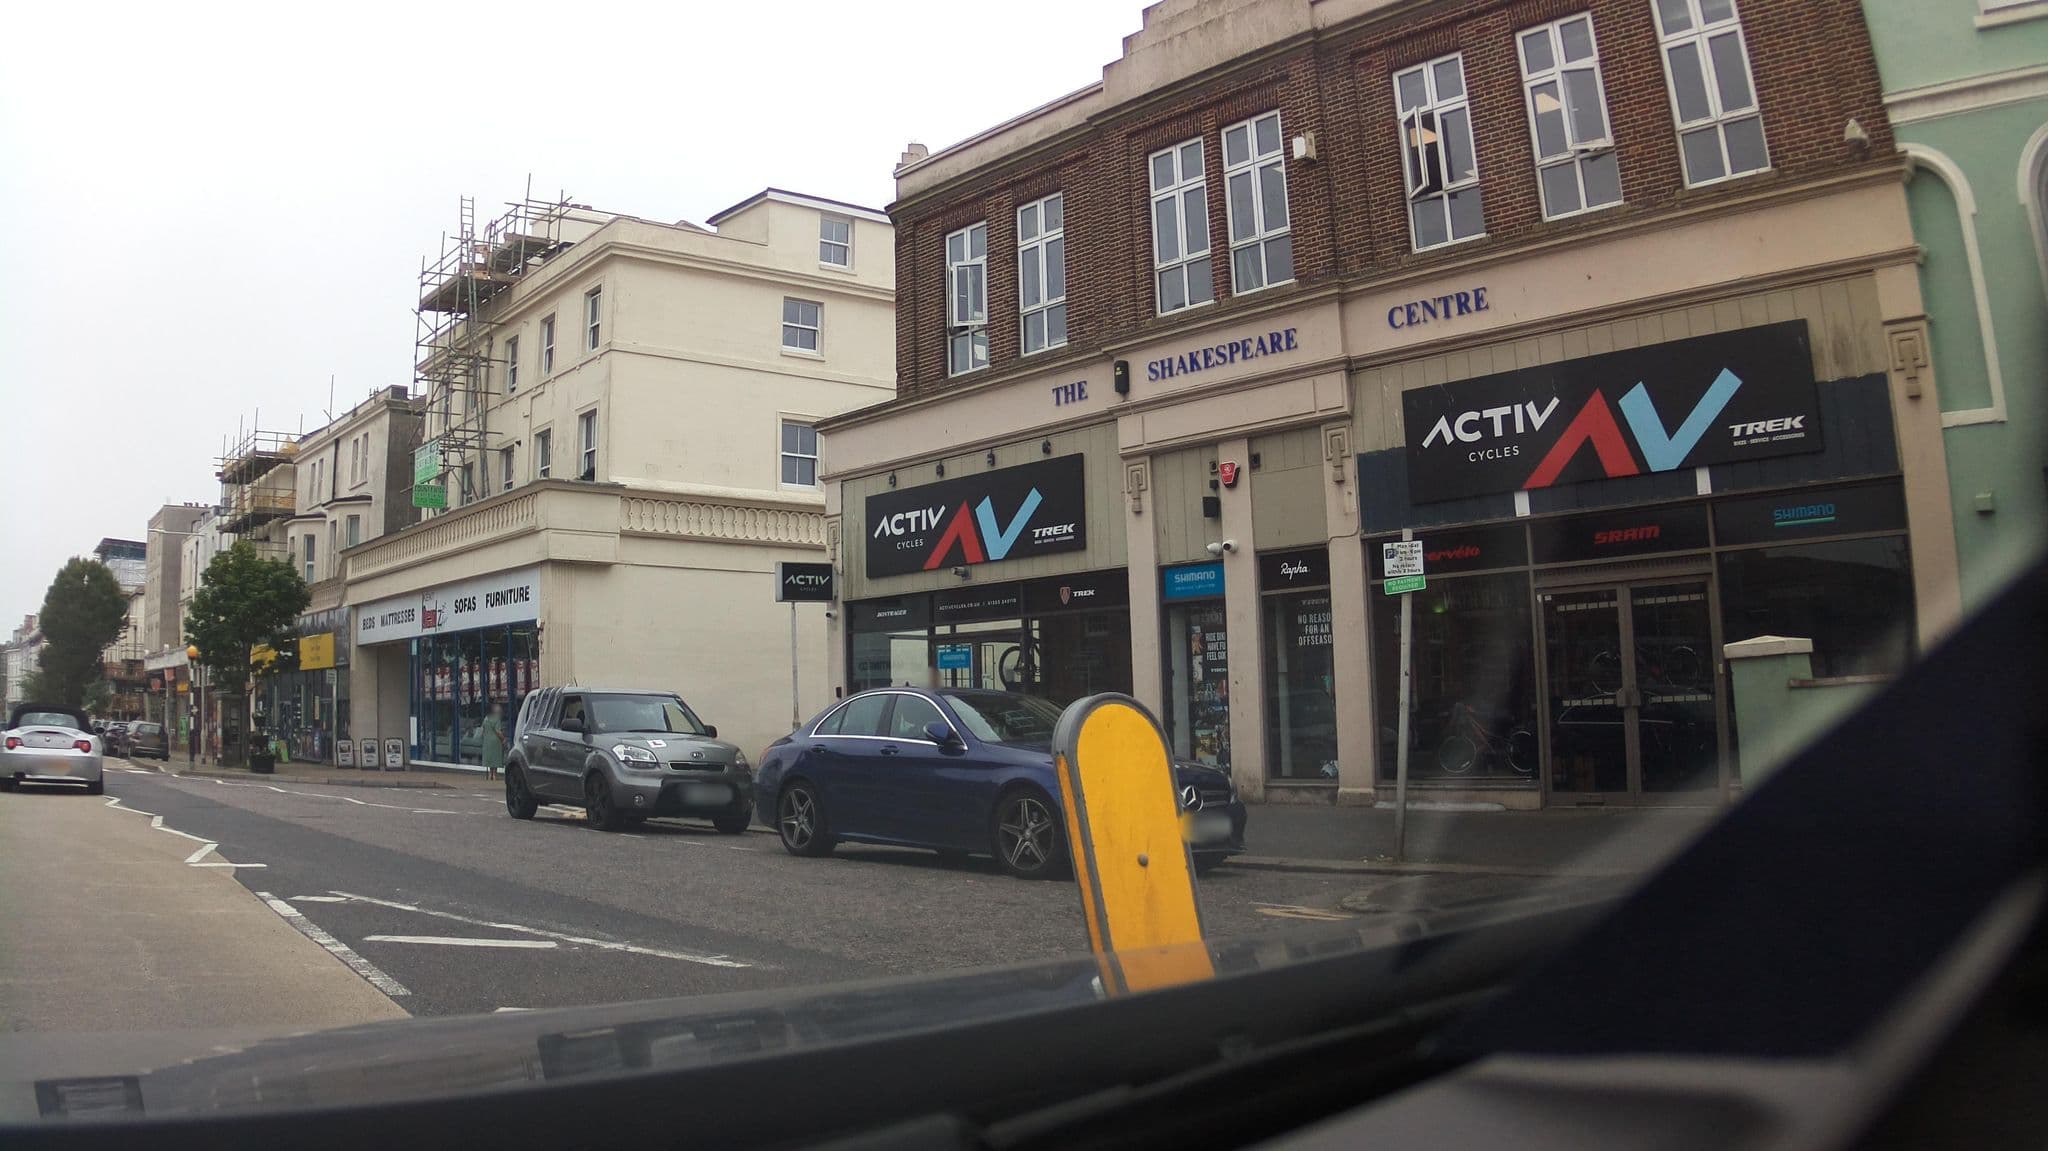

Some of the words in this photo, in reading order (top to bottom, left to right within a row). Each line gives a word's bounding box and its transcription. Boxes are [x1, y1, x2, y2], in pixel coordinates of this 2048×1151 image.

[1052, 380, 1088, 407] THE
[1147, 327, 1298, 382] SHAKESPEARE
[1387, 286, 1490, 330] CENTRE
[1421, 396, 1560, 449] ACTIV
[1728, 414, 1806, 438] TREK
[1468, 445, 1520, 462] CYCLES
[1774, 502, 1836, 521] SHIMANO
[874, 504, 946, 539] ACTIV
[1032, 523, 1076, 538] TREK
[1594, 525, 1660, 545] SRAM
[896, 538, 924, 550] CYCLES
[1427, 545, 1480, 561] ervélo
[1174, 570, 1216, 583] SHIMANO
[1281, 559, 1308, 580] Rapha
[785, 574, 830, 586] ACTIV
[454, 596, 477, 615] SOFAS
[485, 585, 530, 609] FURNITURE
[1073, 589, 1095, 597] TREK
[362, 616, 376, 631] BEDS
[380, 608, 415, 628] MATTRESSES
[1297, 614, 1307, 625] NO
[1309, 612, 1331, 624] REASO
[1305, 624, 1319, 635] FOR
[1320, 623, 1330, 633] AN
[1298, 634, 1332, 646] OFFSEASO
[1206, 651, 1217, 661] FEEL
